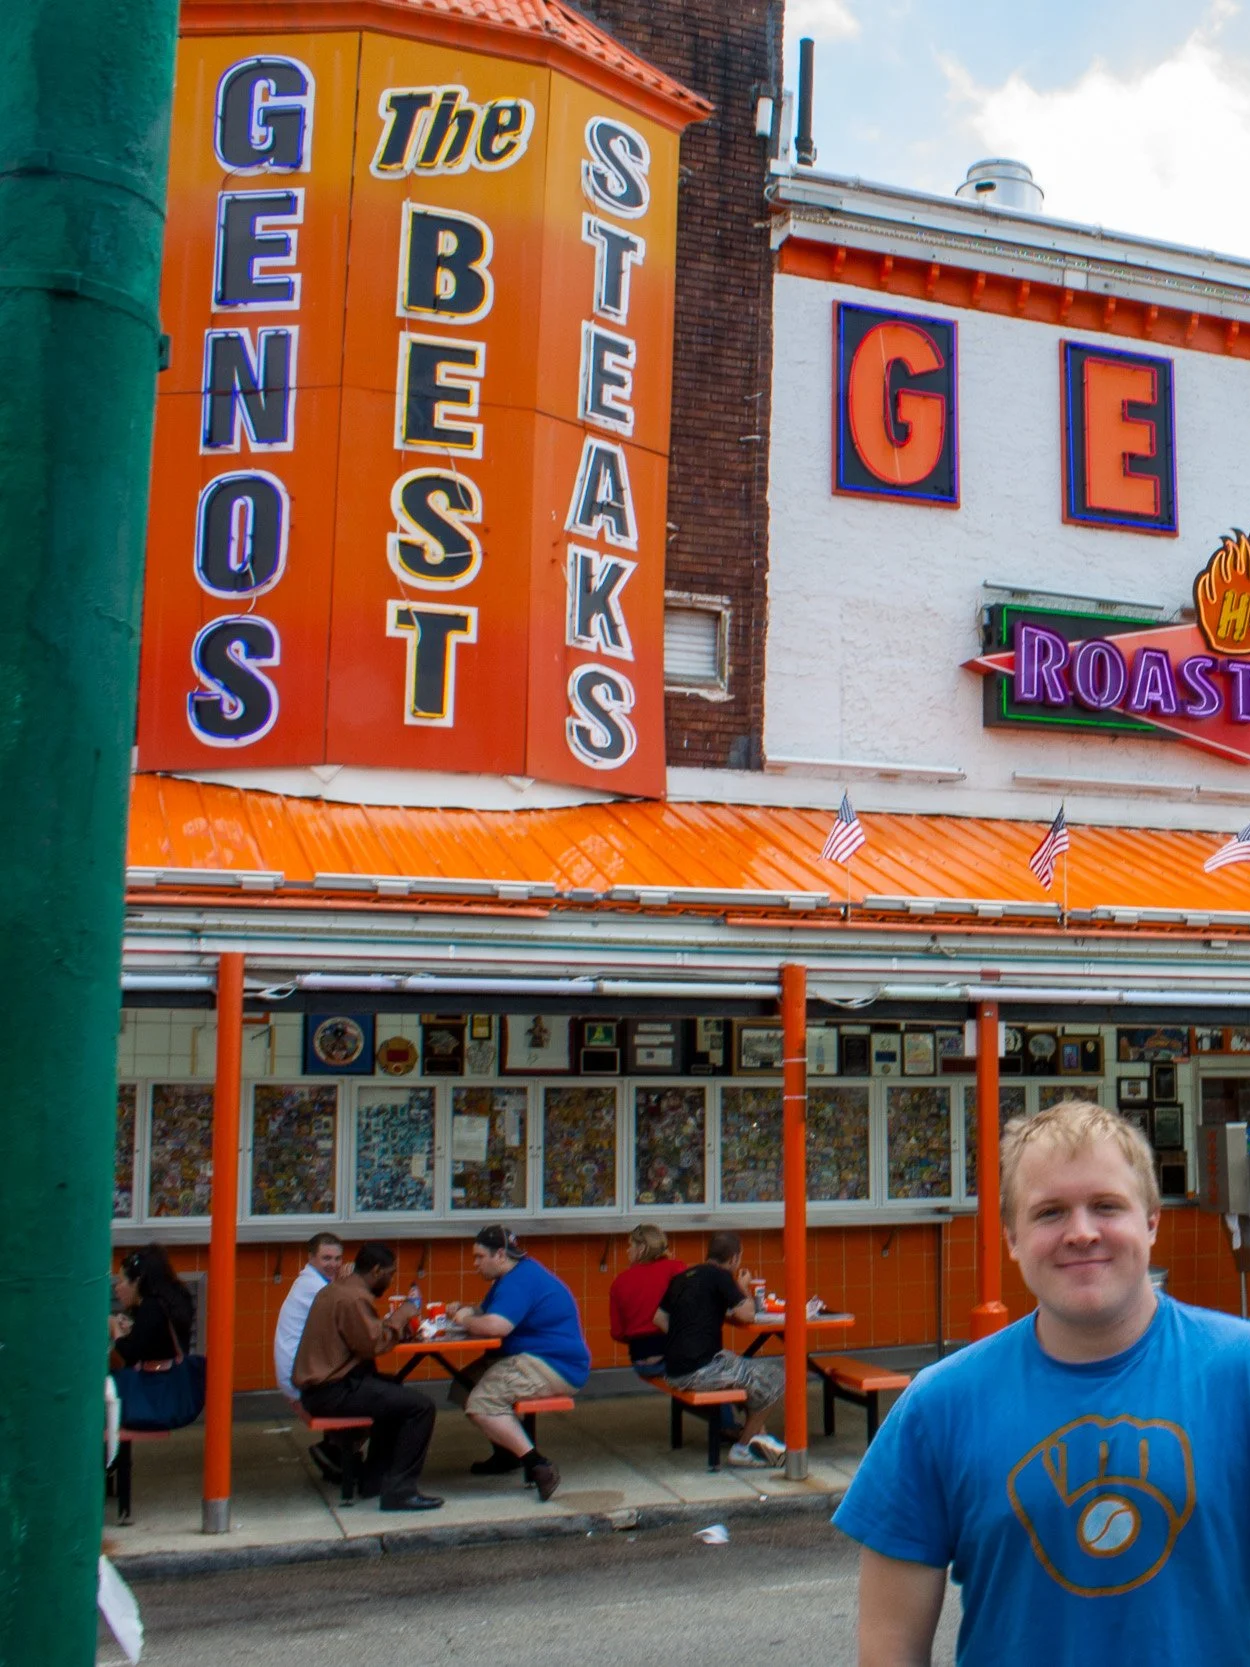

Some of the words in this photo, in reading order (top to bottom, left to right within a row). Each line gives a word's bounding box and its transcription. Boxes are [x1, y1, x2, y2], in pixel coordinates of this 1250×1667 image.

[187, 54, 316, 748] GENOS
[369, 85, 534, 180] The
[386, 199, 494, 727] BEST
[564, 115, 651, 770] STEAKS
